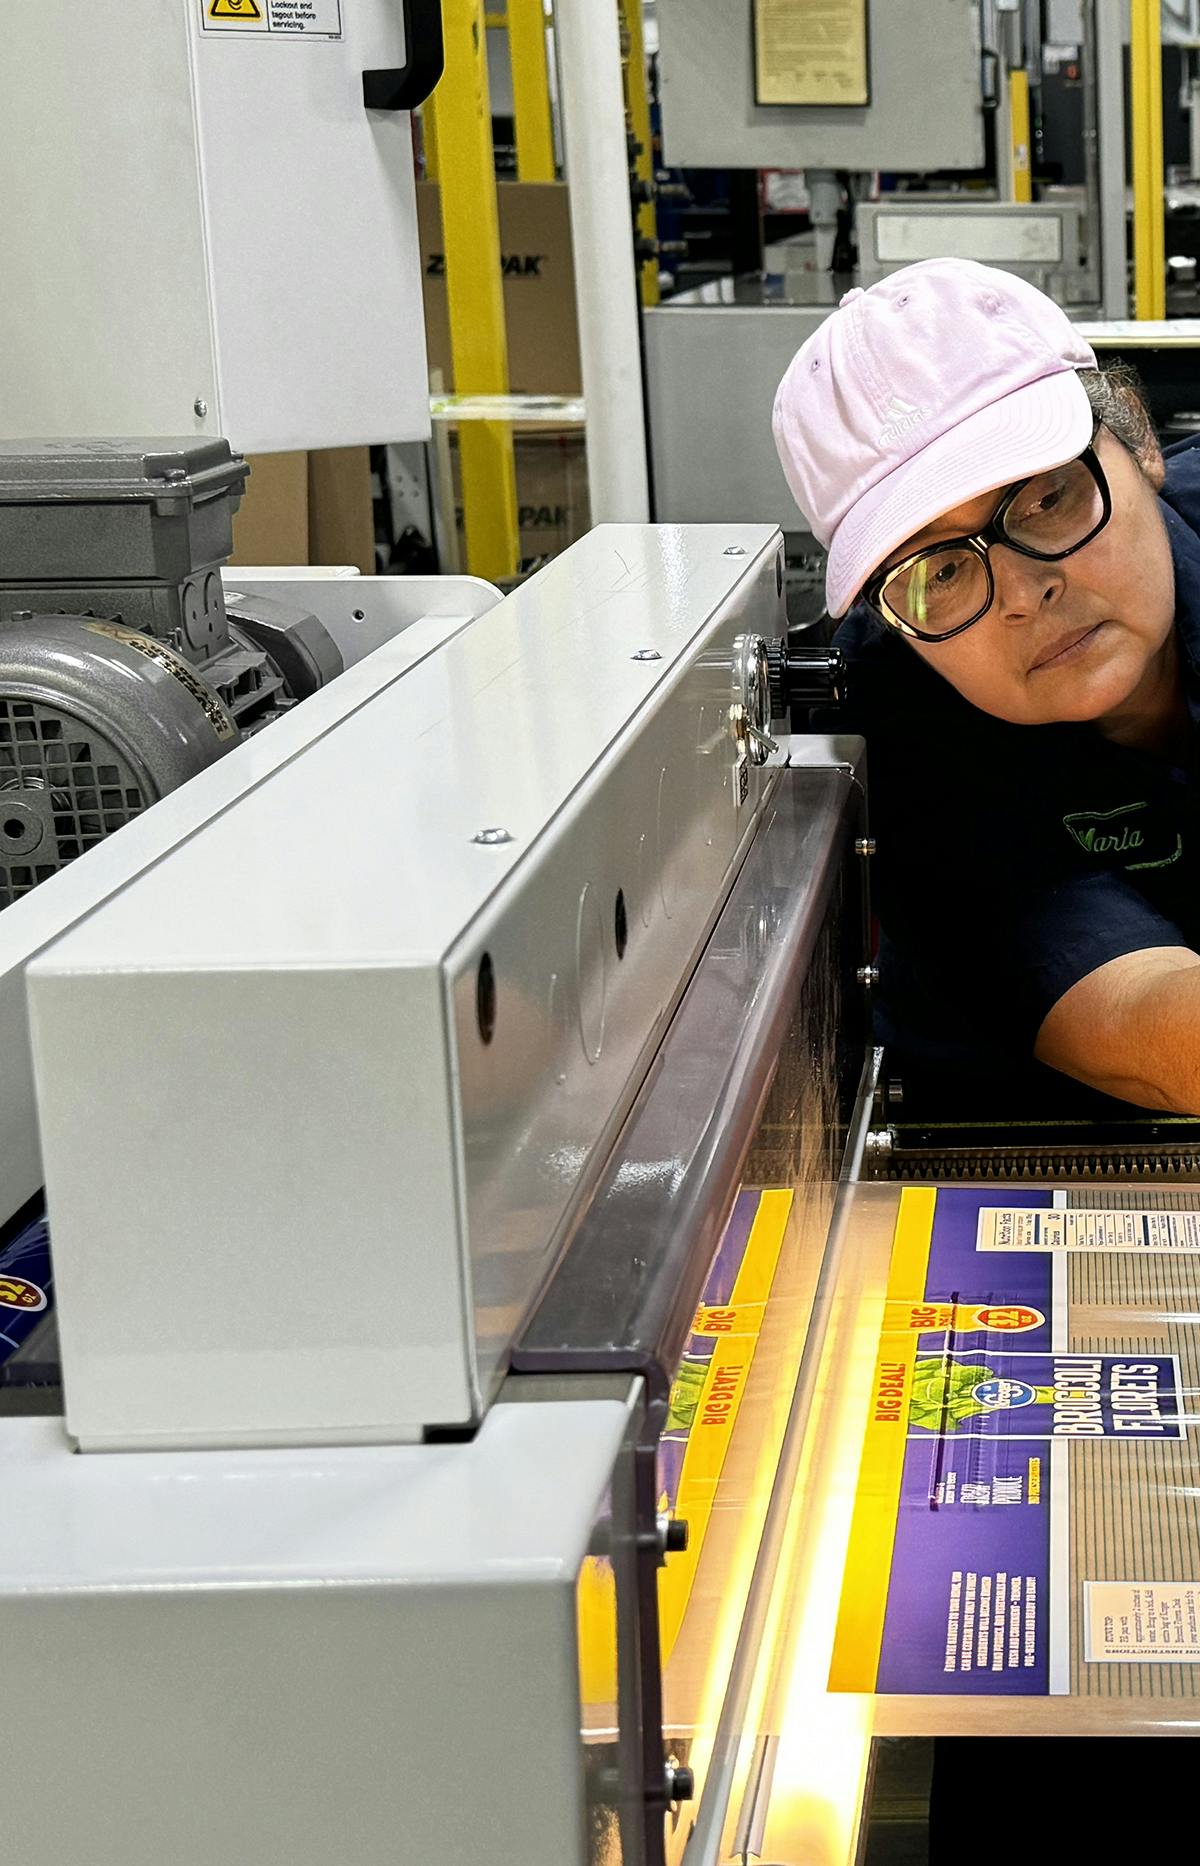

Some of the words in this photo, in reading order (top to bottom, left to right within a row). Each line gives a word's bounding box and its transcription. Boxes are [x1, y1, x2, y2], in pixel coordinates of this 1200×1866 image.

[909, 1307, 937, 1328] BIG
[987, 1311, 1020, 1326] 32
[878, 1363, 905, 1397] DEAL!
[1053, 1359, 1105, 1434] BROCCOLI
[1110, 1364, 1164, 1431] FLORETS
[875, 1400, 902, 1421] BIG
